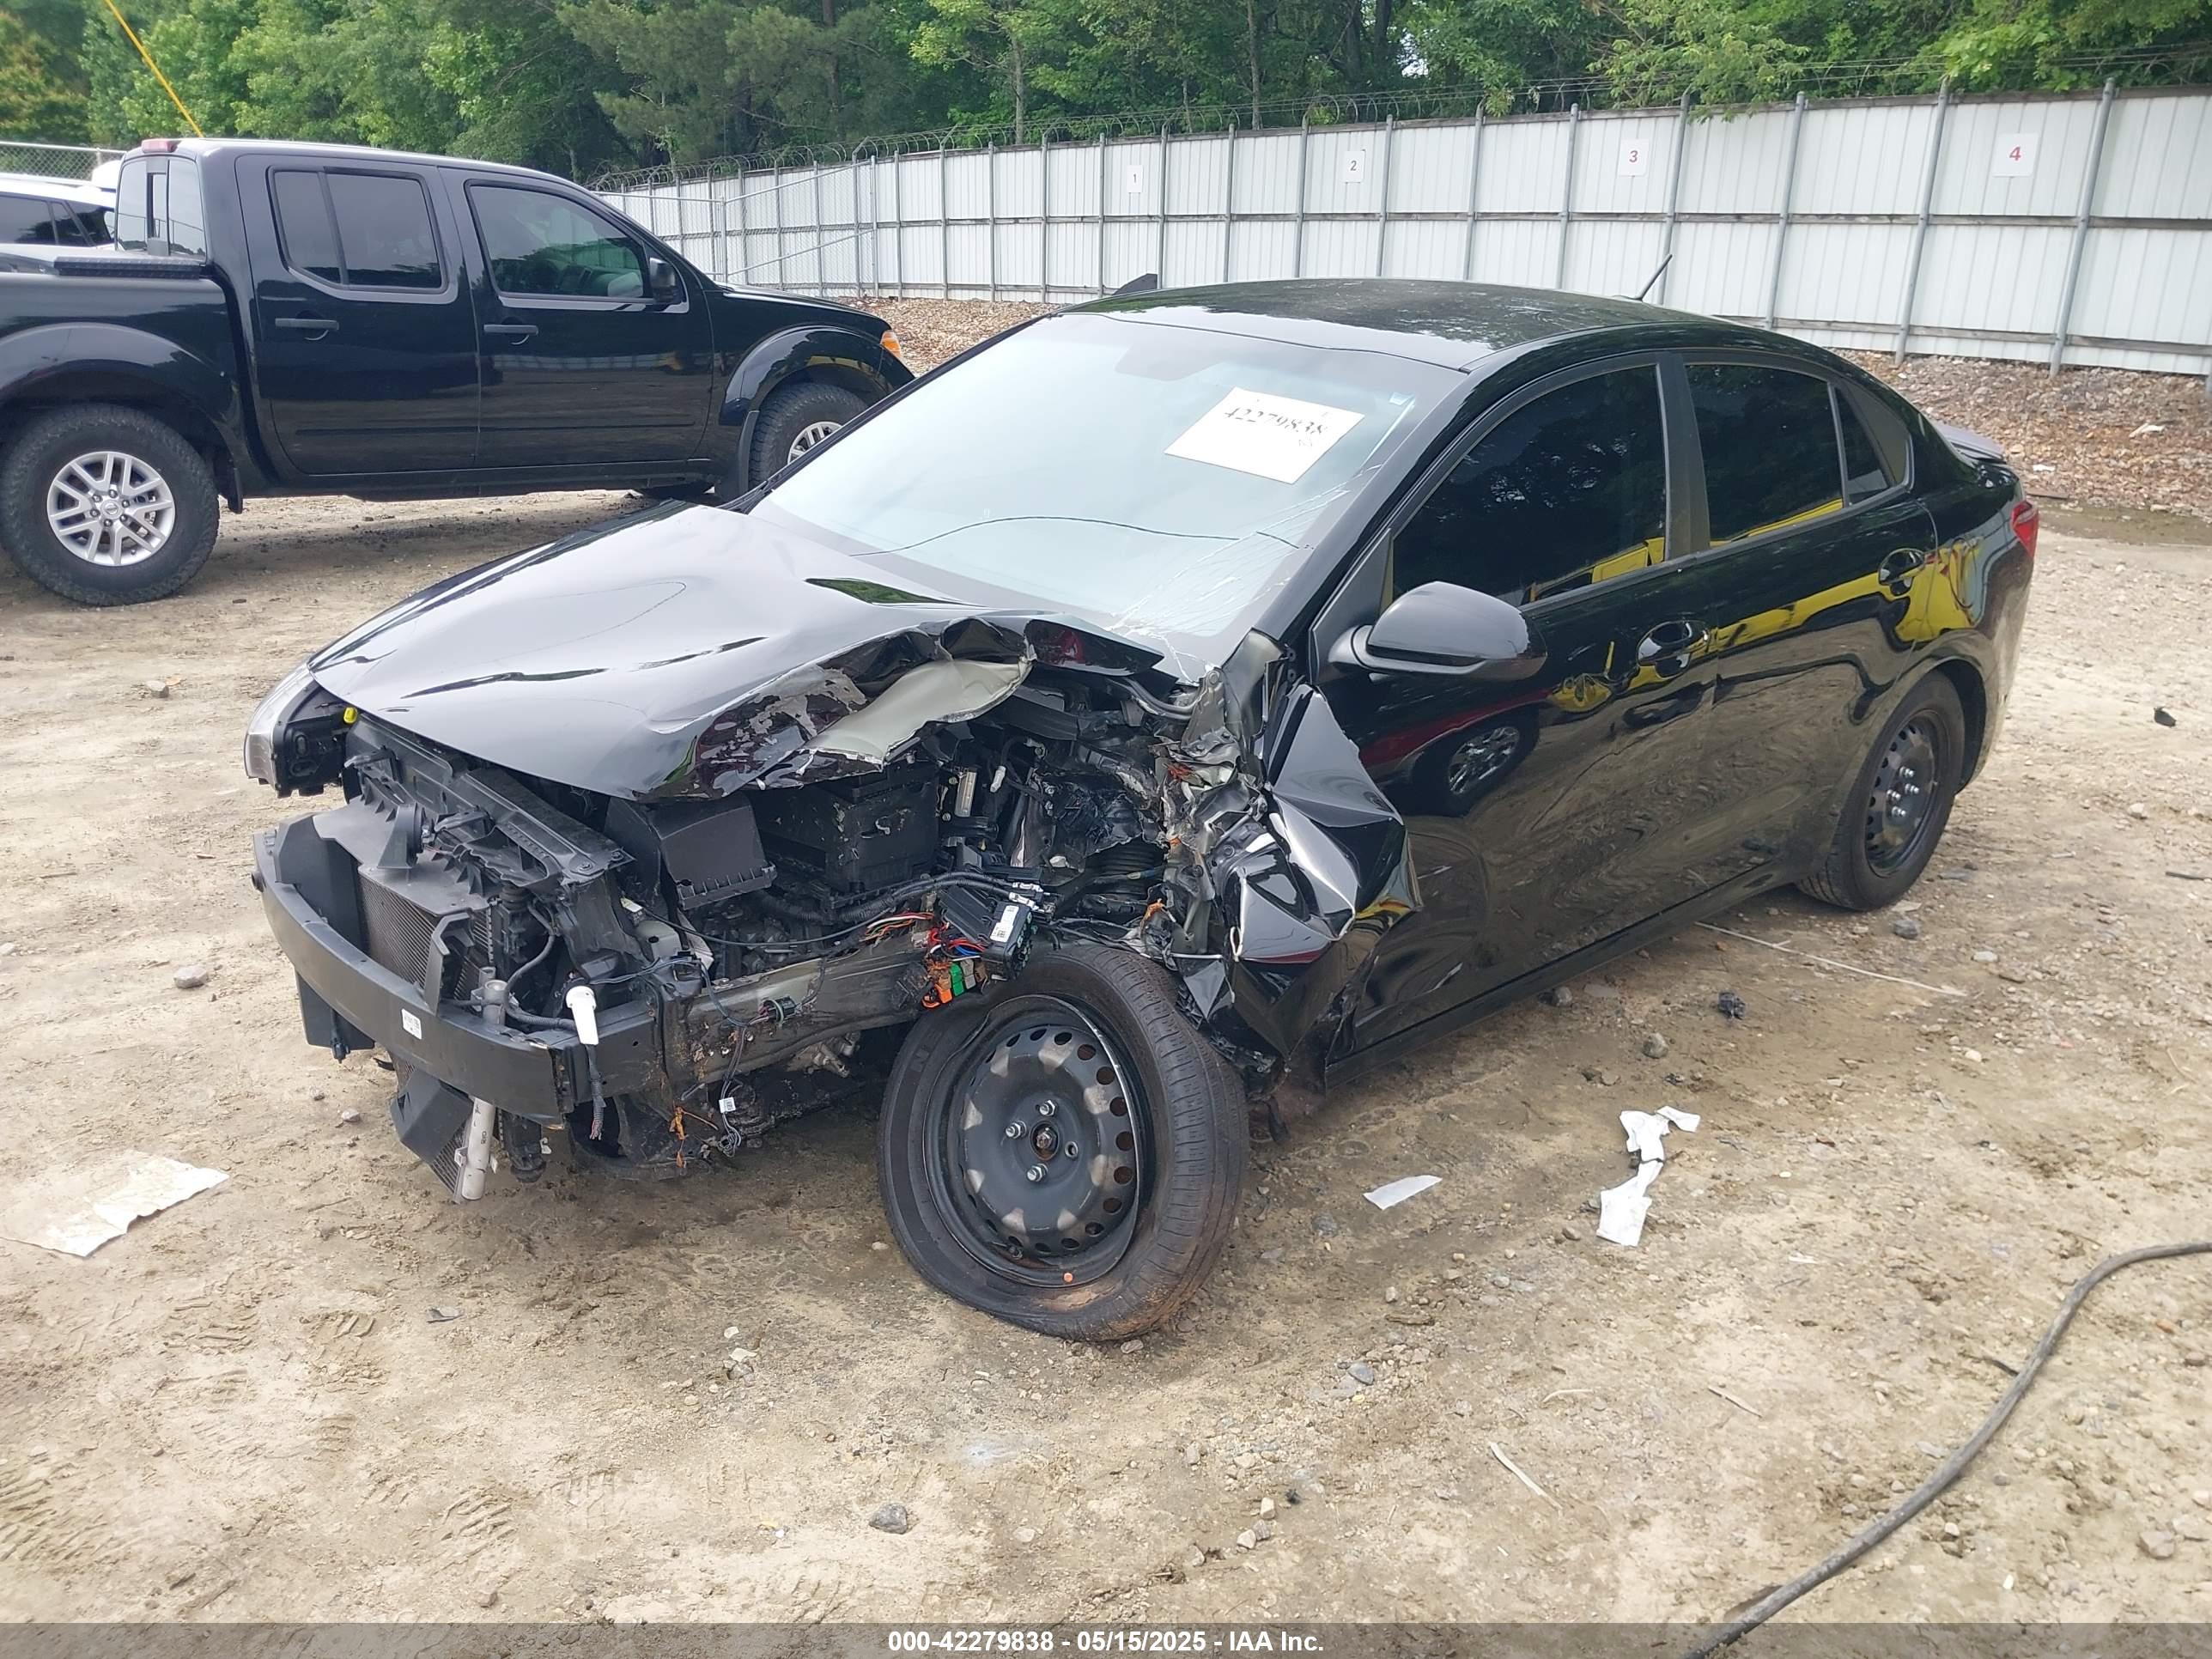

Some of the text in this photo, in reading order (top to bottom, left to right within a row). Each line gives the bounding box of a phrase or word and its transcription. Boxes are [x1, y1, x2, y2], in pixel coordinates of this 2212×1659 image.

[1628, 149, 1638, 163] 3
[2008, 146, 2022, 161] 4
[1350, 160, 1358, 172] 2
[1224, 406, 1328, 435] 42279838
